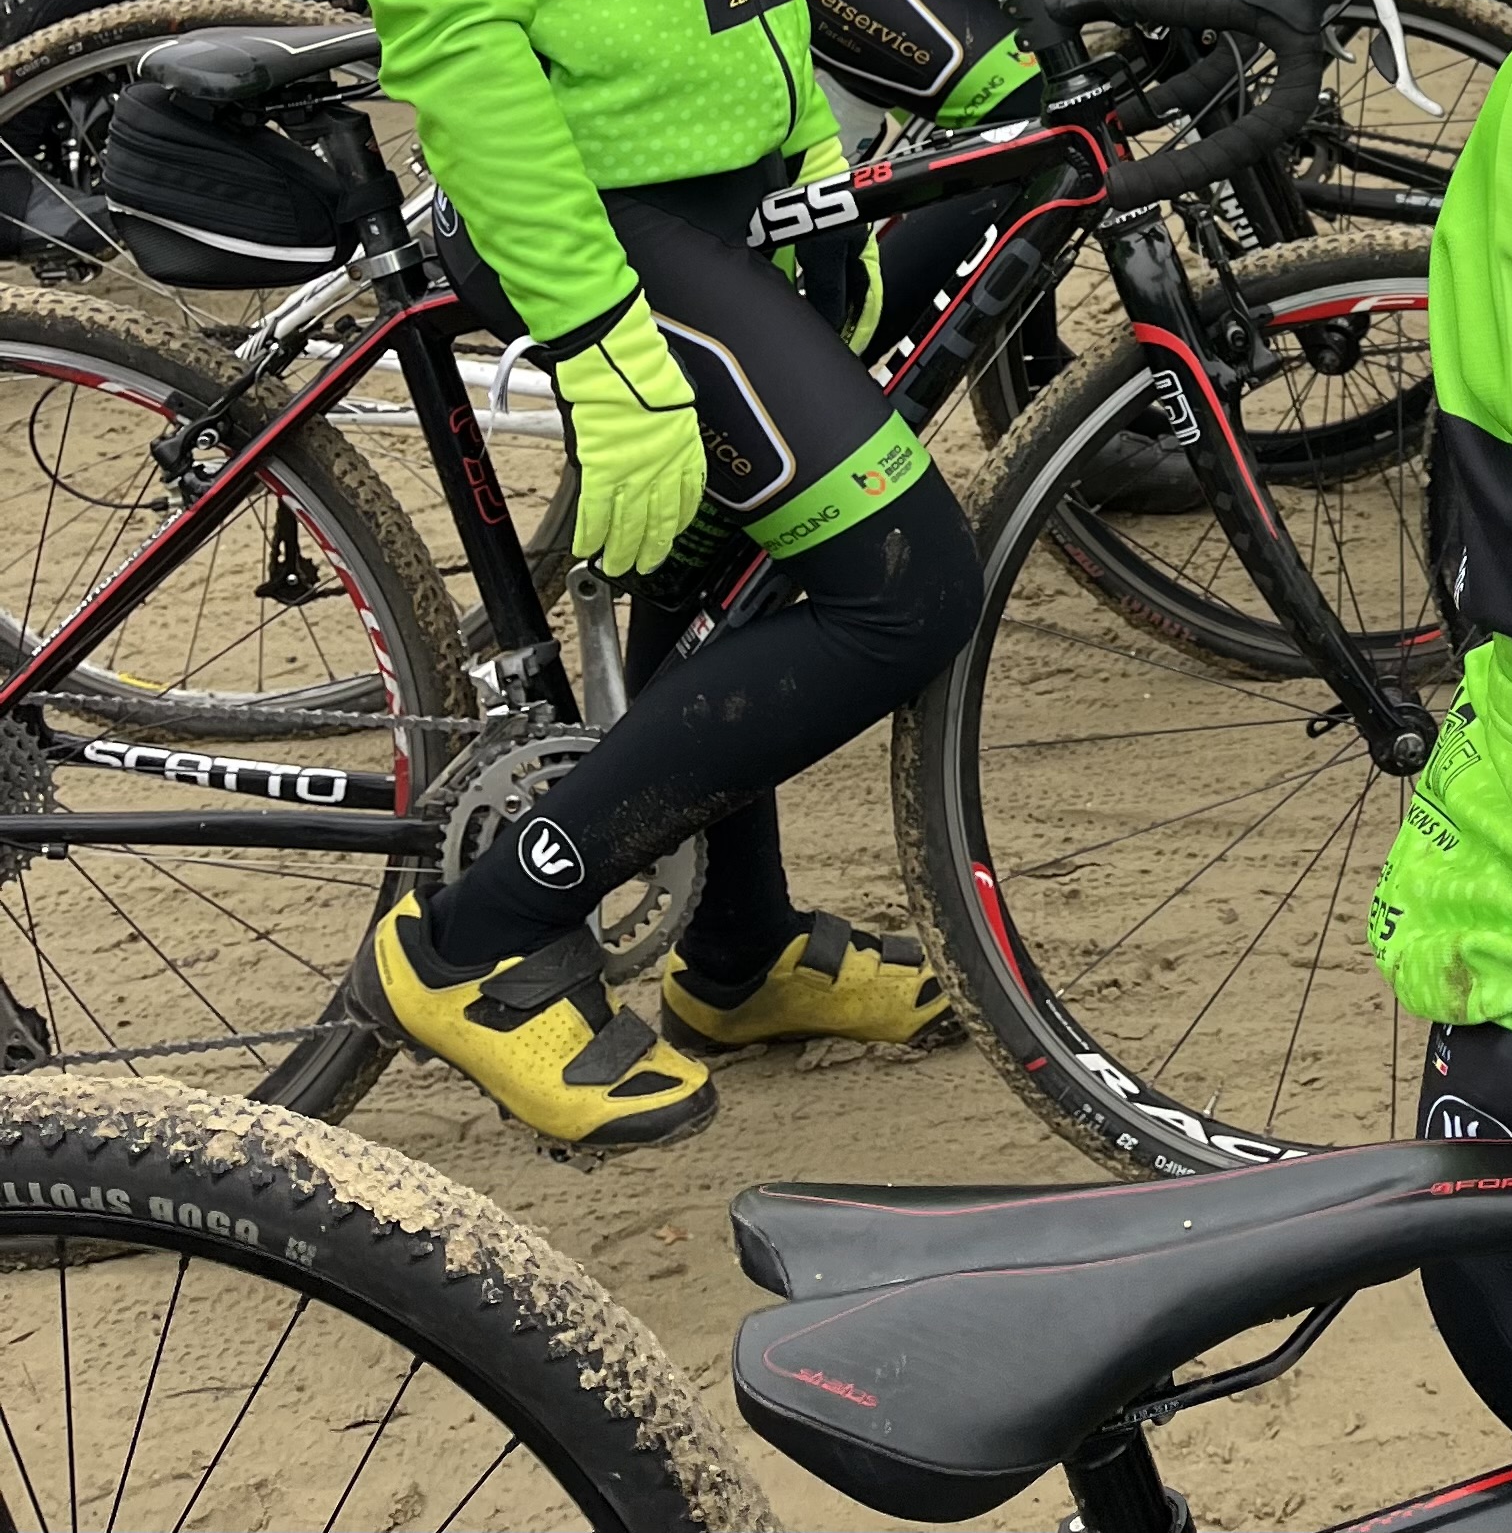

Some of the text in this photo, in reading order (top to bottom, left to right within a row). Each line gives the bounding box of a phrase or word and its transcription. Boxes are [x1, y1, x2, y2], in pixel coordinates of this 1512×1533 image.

[851, 161, 894, 189] 28
[779, 504, 841, 545] CYCLING
[83, 739, 348, 804] SCATTO
